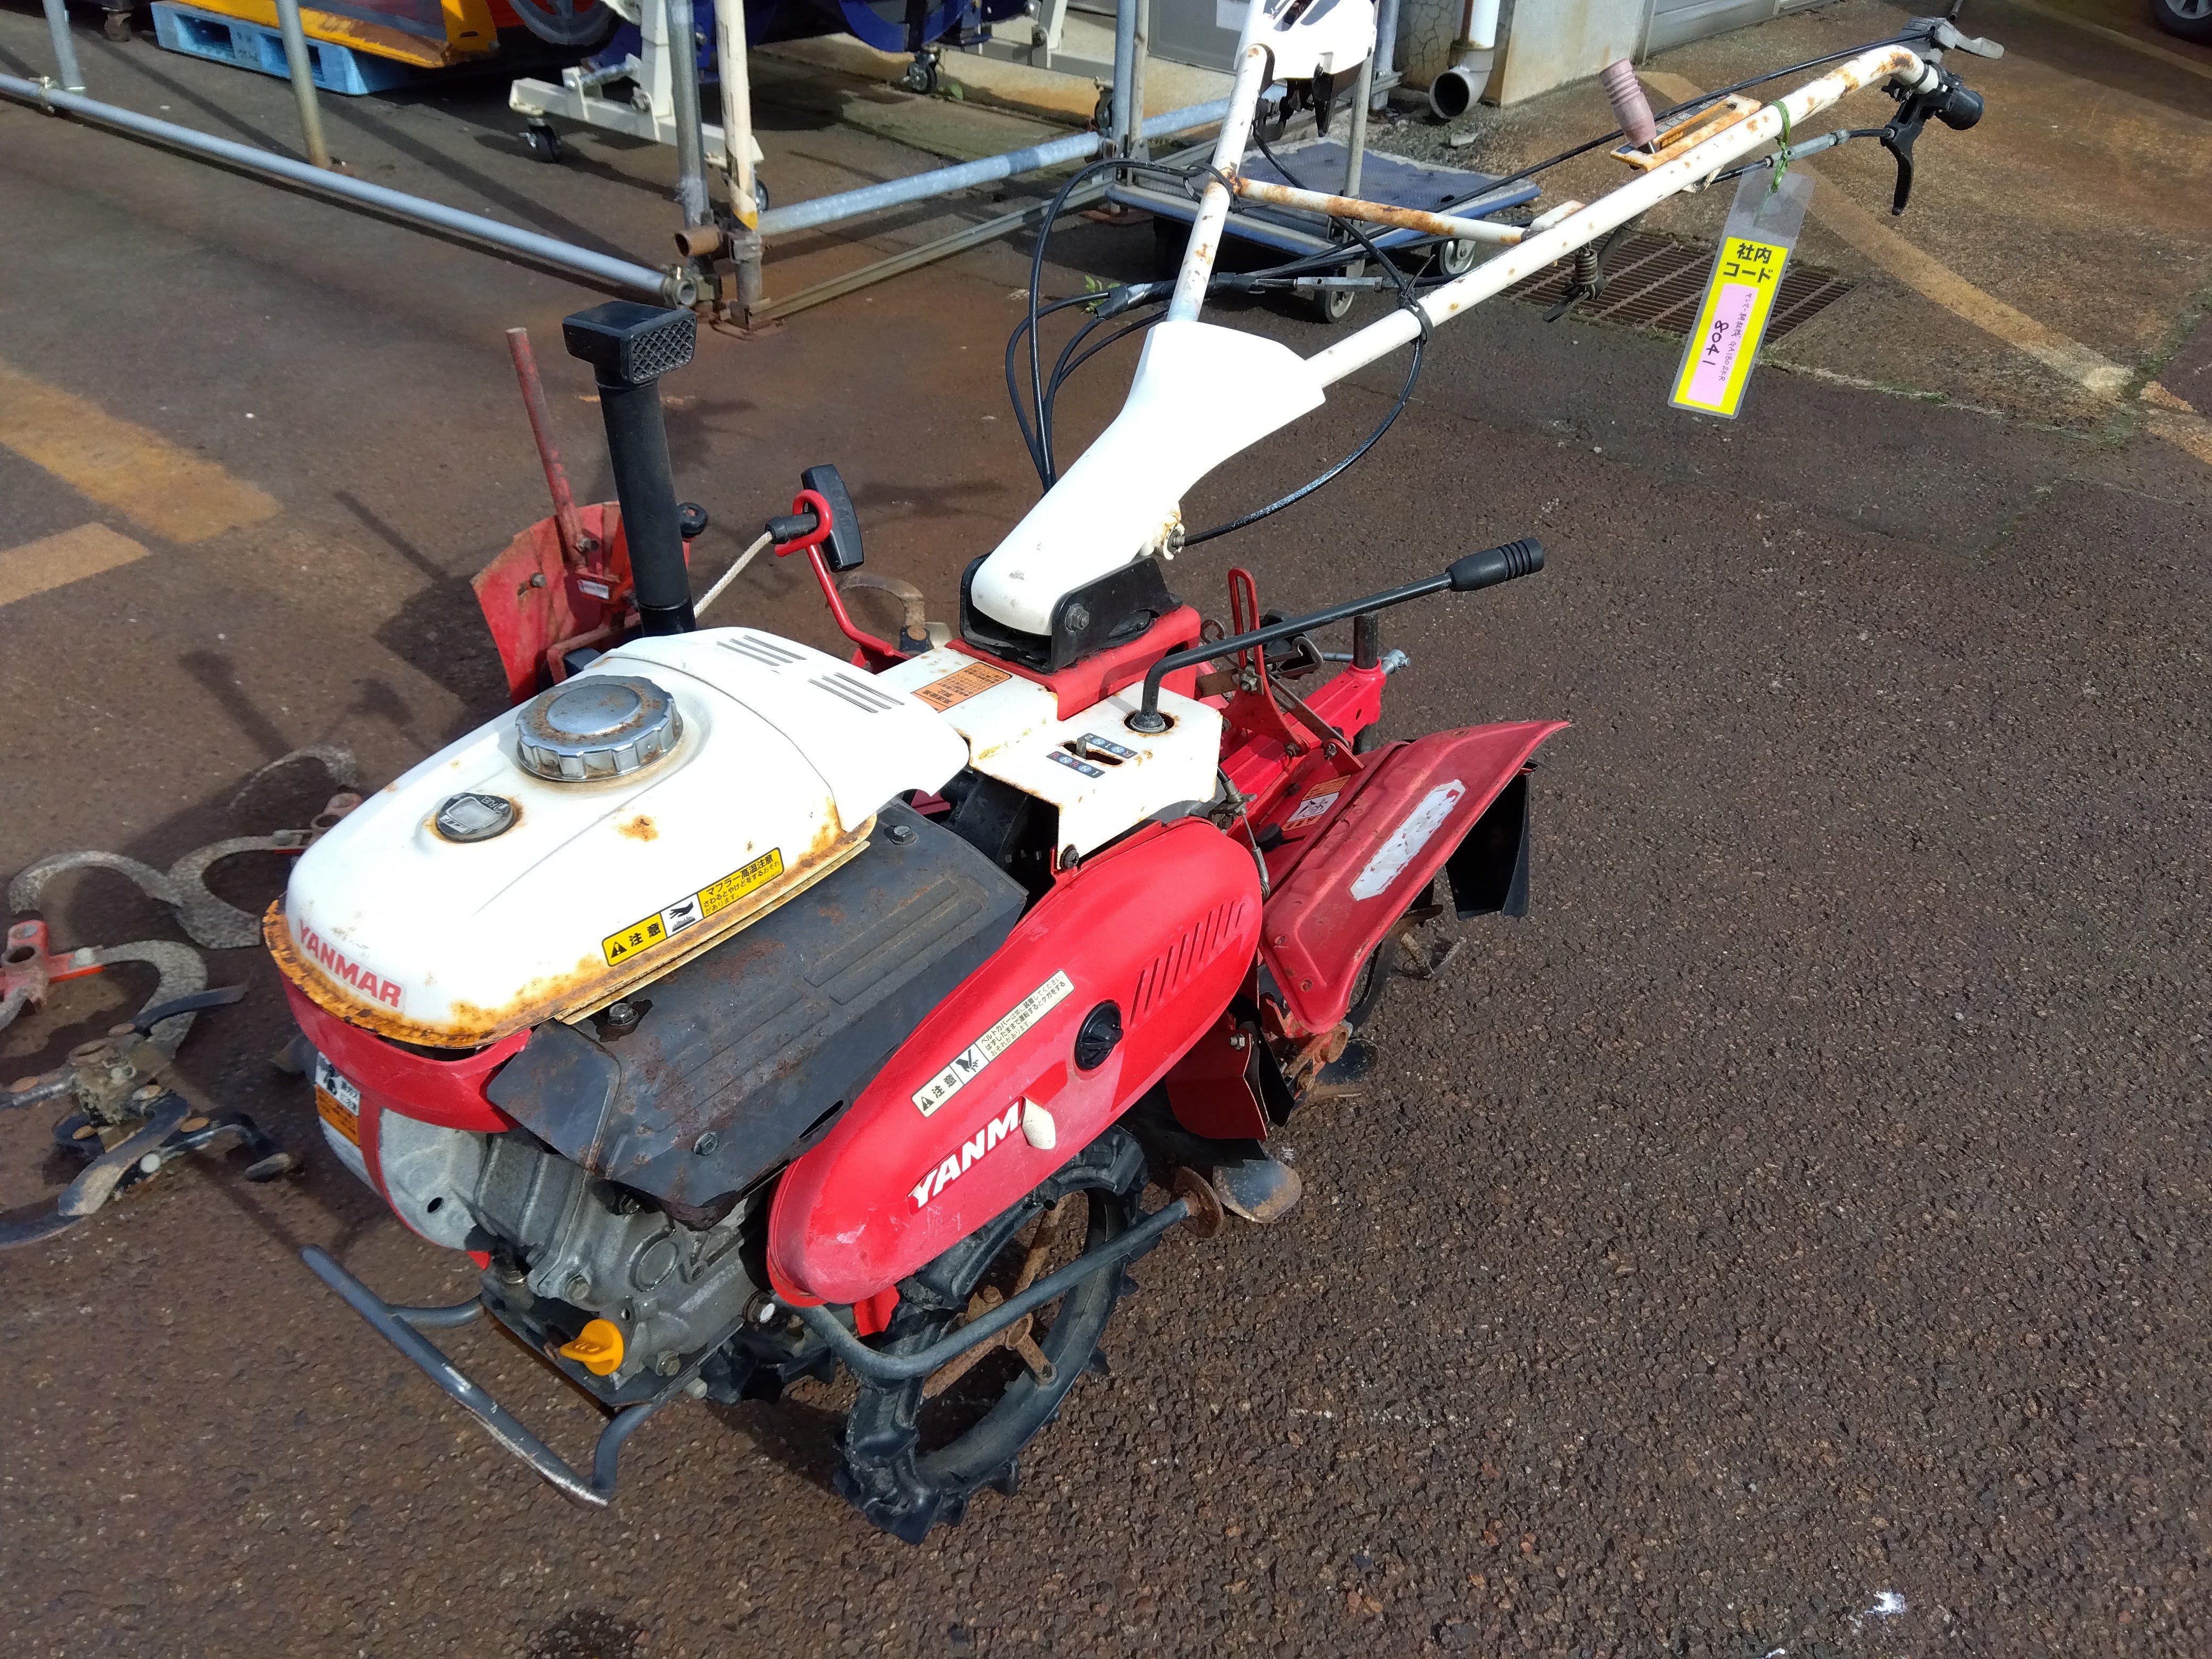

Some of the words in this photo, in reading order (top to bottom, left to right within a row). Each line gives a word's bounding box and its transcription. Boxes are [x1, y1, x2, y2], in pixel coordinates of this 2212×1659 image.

[1723, 262, 1773, 283] コード
[1736, 242, 1773, 264] 社内
[1702, 320, 1729, 366] 8041
[702, 861, 781, 908] さわるとやけどをするおそれ
[706, 853, 774, 895] マフラー高温注意
[705, 894, 740, 915] があります。
[629, 922, 661, 947] 注意
[300, 919, 402, 1008] YANMAR
[981, 975, 1064, 1044] ベルトカバーは常に装着してください。
[985, 981, 1066, 1051] はずしたままで運転するとケガをする
[991, 1020, 1033, 1057] おそれがあります。
[931, 1073, 957, 1099] 注意
[913, 1101, 1020, 1208] YANM
